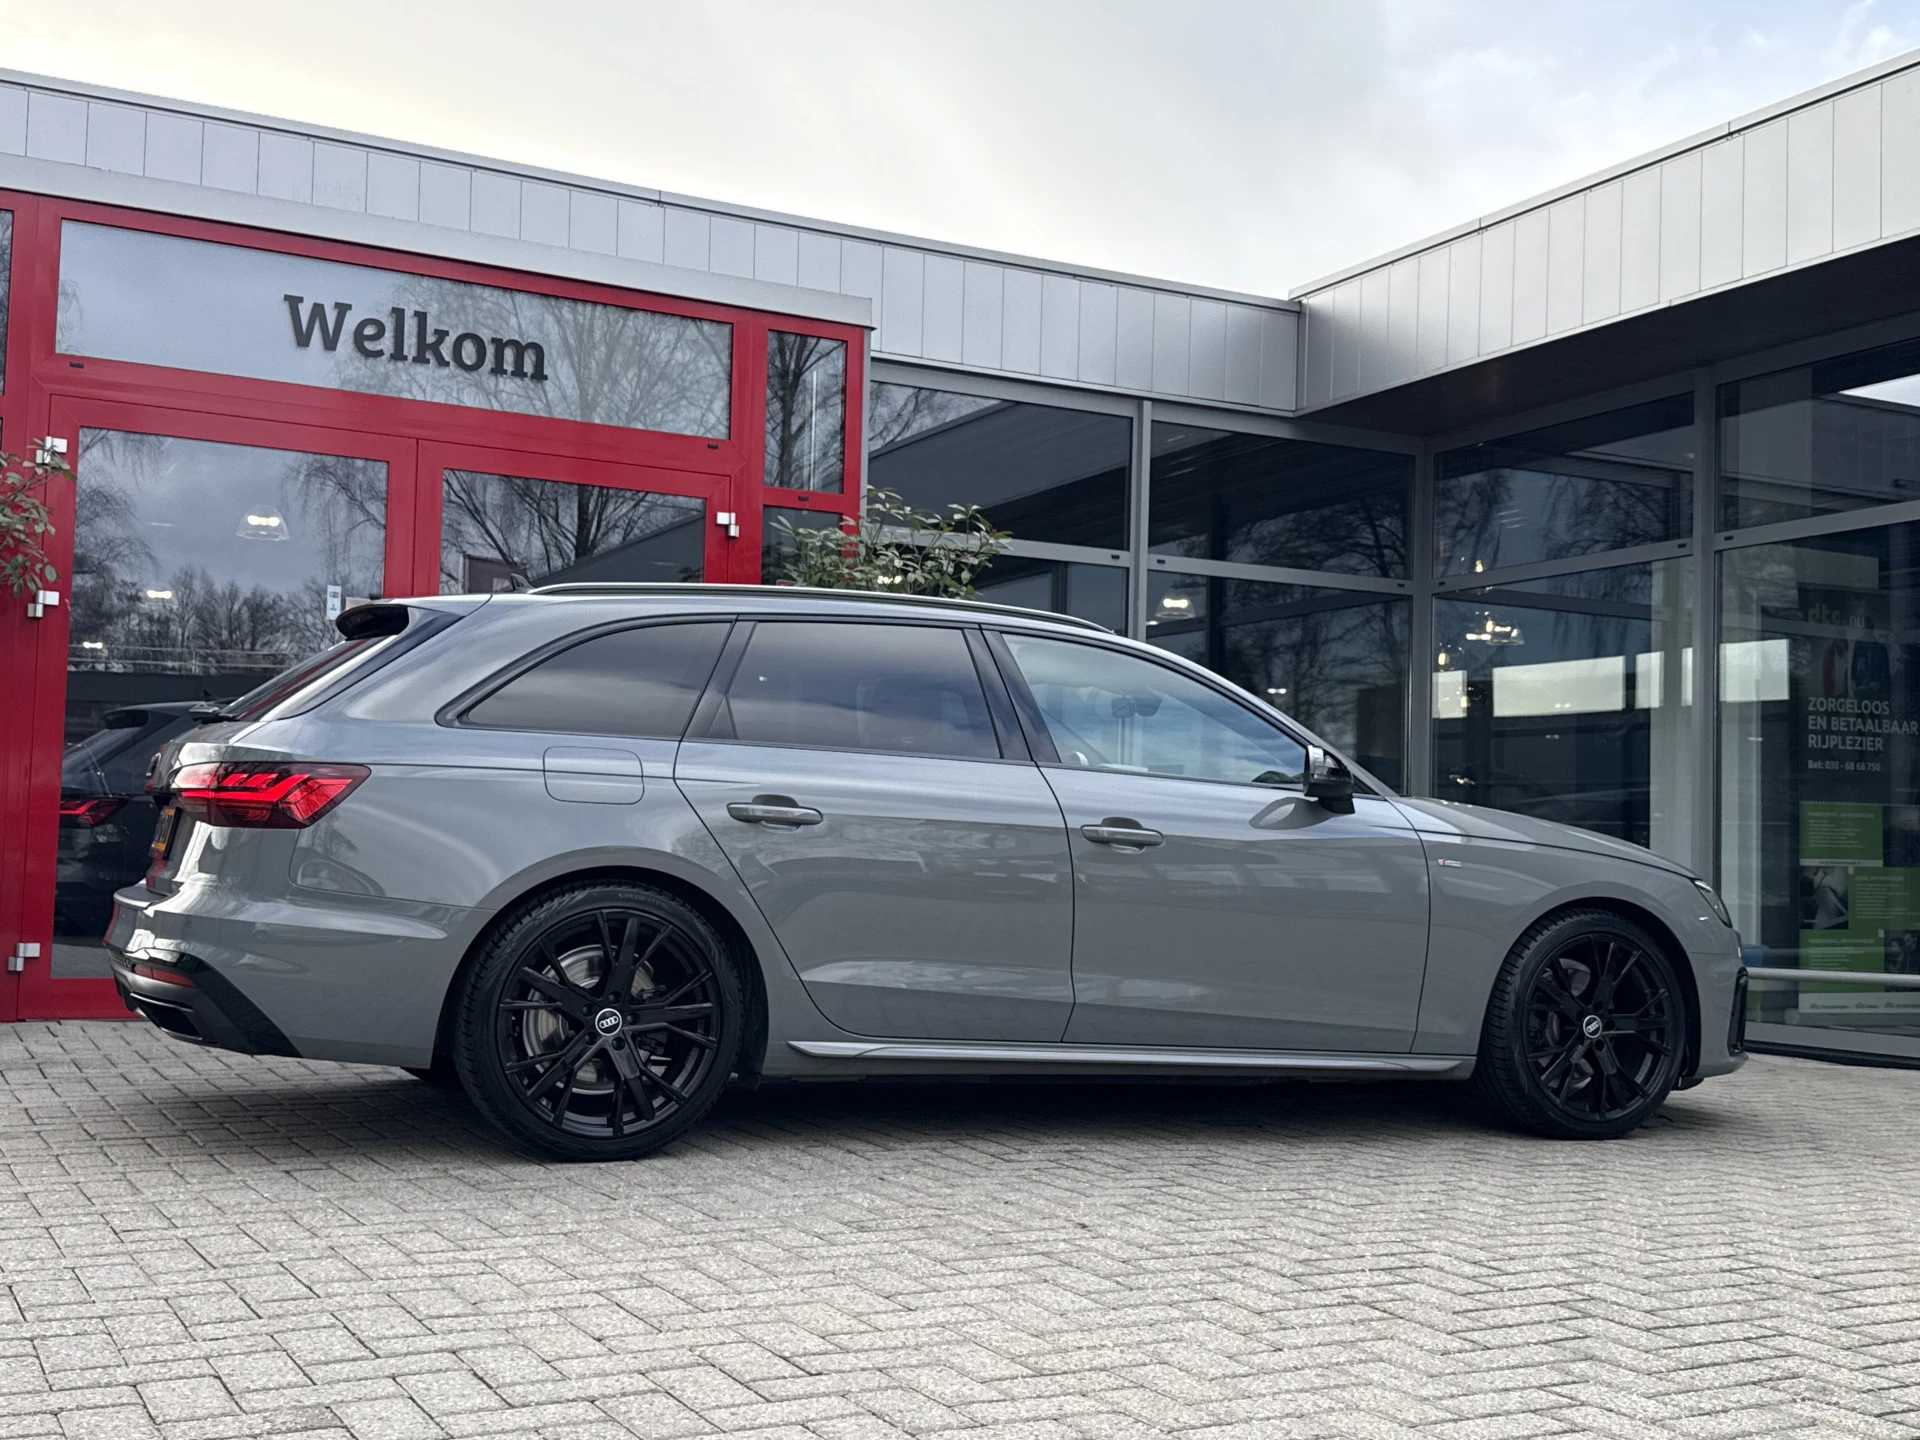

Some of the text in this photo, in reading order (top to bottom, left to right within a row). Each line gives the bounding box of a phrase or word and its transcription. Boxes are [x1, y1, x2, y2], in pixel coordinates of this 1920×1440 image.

[283, 294, 549, 381] Welkom
[1808, 697, 1890, 715] ZORGELOOS
[1808, 715, 1919, 735] EN BETAALBAAR
[1808, 734, 1884, 752] RIJPLEZIER
